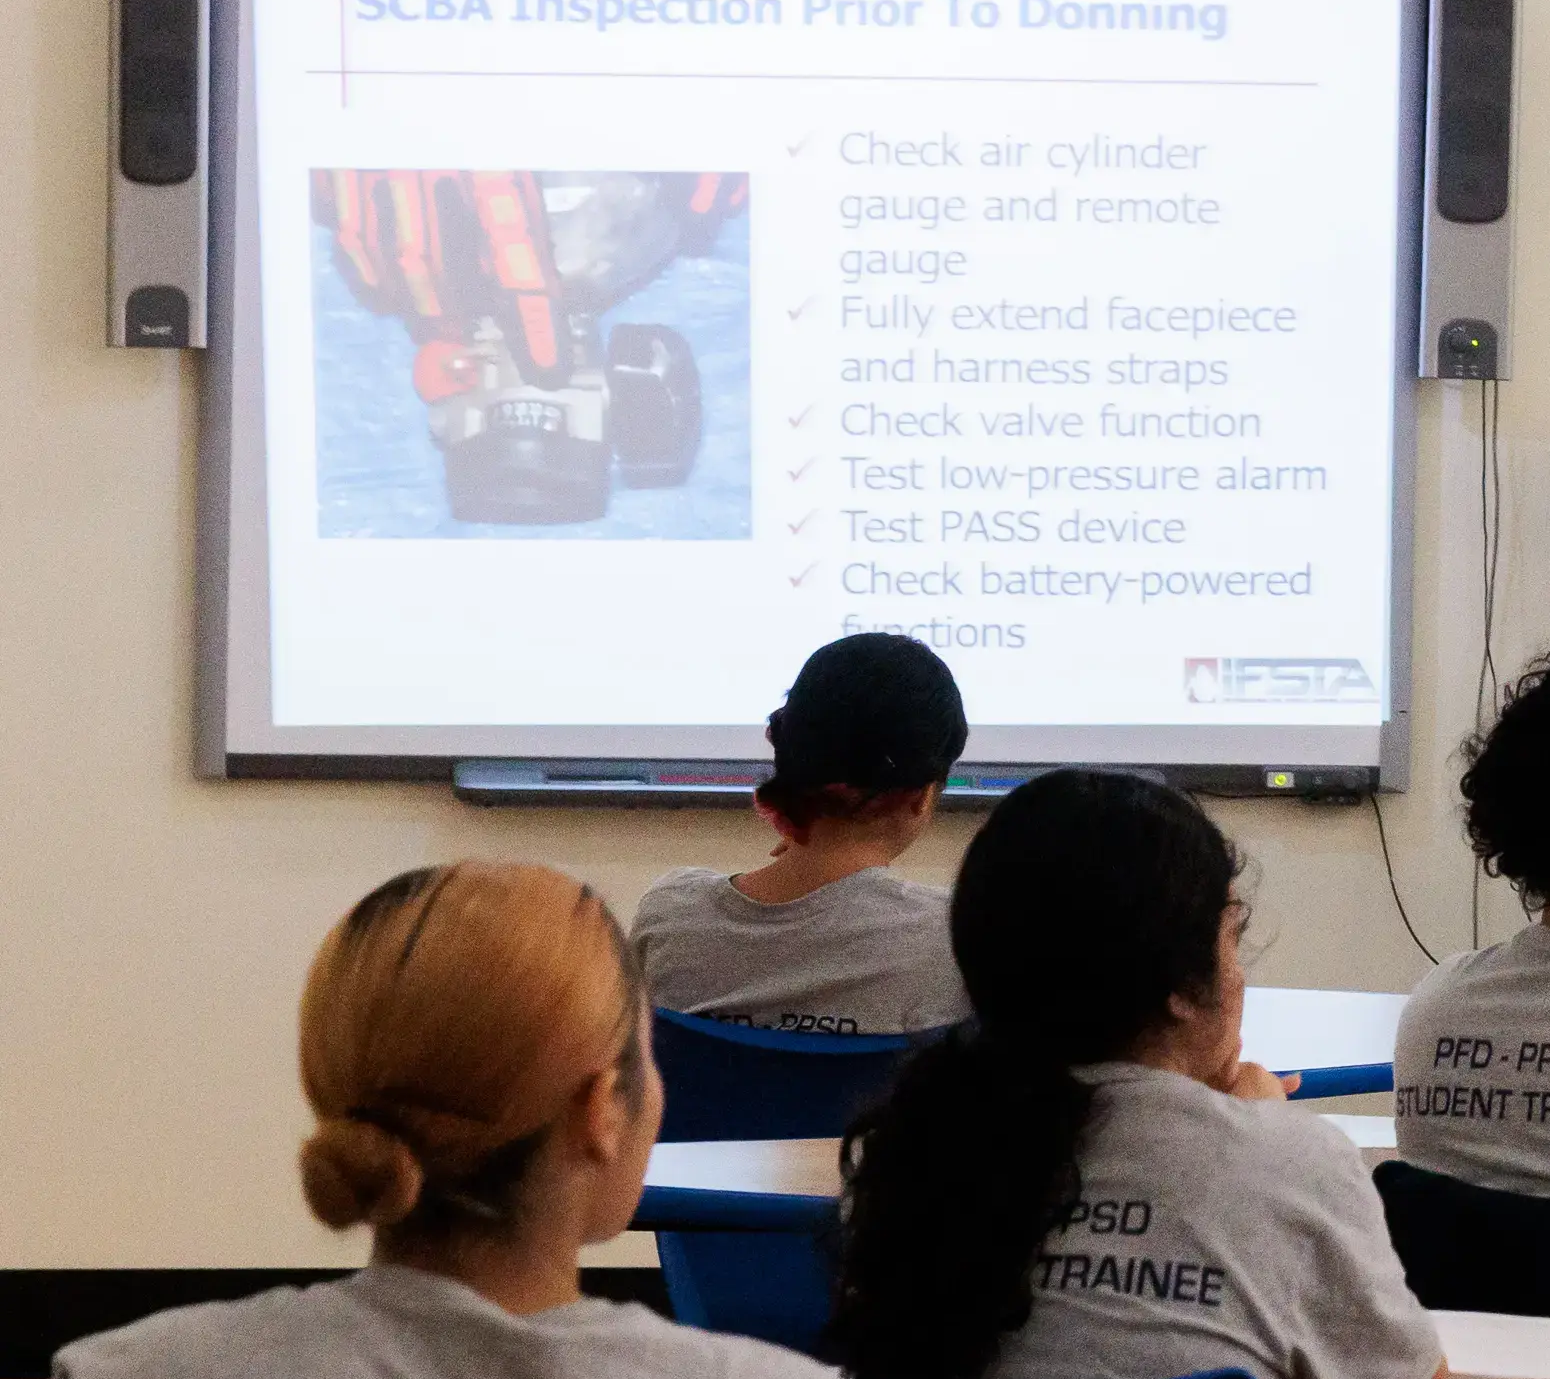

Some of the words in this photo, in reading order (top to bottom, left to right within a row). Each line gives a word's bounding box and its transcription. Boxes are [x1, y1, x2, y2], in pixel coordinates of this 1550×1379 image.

[838, 131, 963, 168] Check
[979, 134, 1032, 168] air
[1046, 133, 1208, 177] cylinder
[839, 195, 967, 231] gauge
[983, 188, 1058, 222] and
[1076, 192, 1221, 225] remote
[839, 249, 968, 285] gauge
[840, 295, 935, 338] Fully
[950, 296, 1089, 332] extend
[1107, 295, 1297, 340] facepiece
[840, 349, 916, 383] and
[933, 348, 1092, 385] harness
[1106, 353, 1230, 394] straps
[840, 402, 963, 438] Check
[978, 403, 1085, 439] valve
[1099, 402, 1262, 439] function
[840, 455, 926, 491] Test
[940, 455, 1200, 499] low-pressure
[1215, 456, 1327, 491] alarm
[840, 509, 926, 544] Test
[941, 509, 1042, 544] PASS
[1057, 507, 1187, 544] device
[841, 561, 963, 596] Check
[980, 562, 1313, 605] battery-powered
[1433, 1037, 1493, 1070] PFD
[1396, 1087, 1514, 1120] STUDENT
[1058, 1199, 1151, 1236] PSD
[1037, 1253, 1226, 1307] TRAINEE
